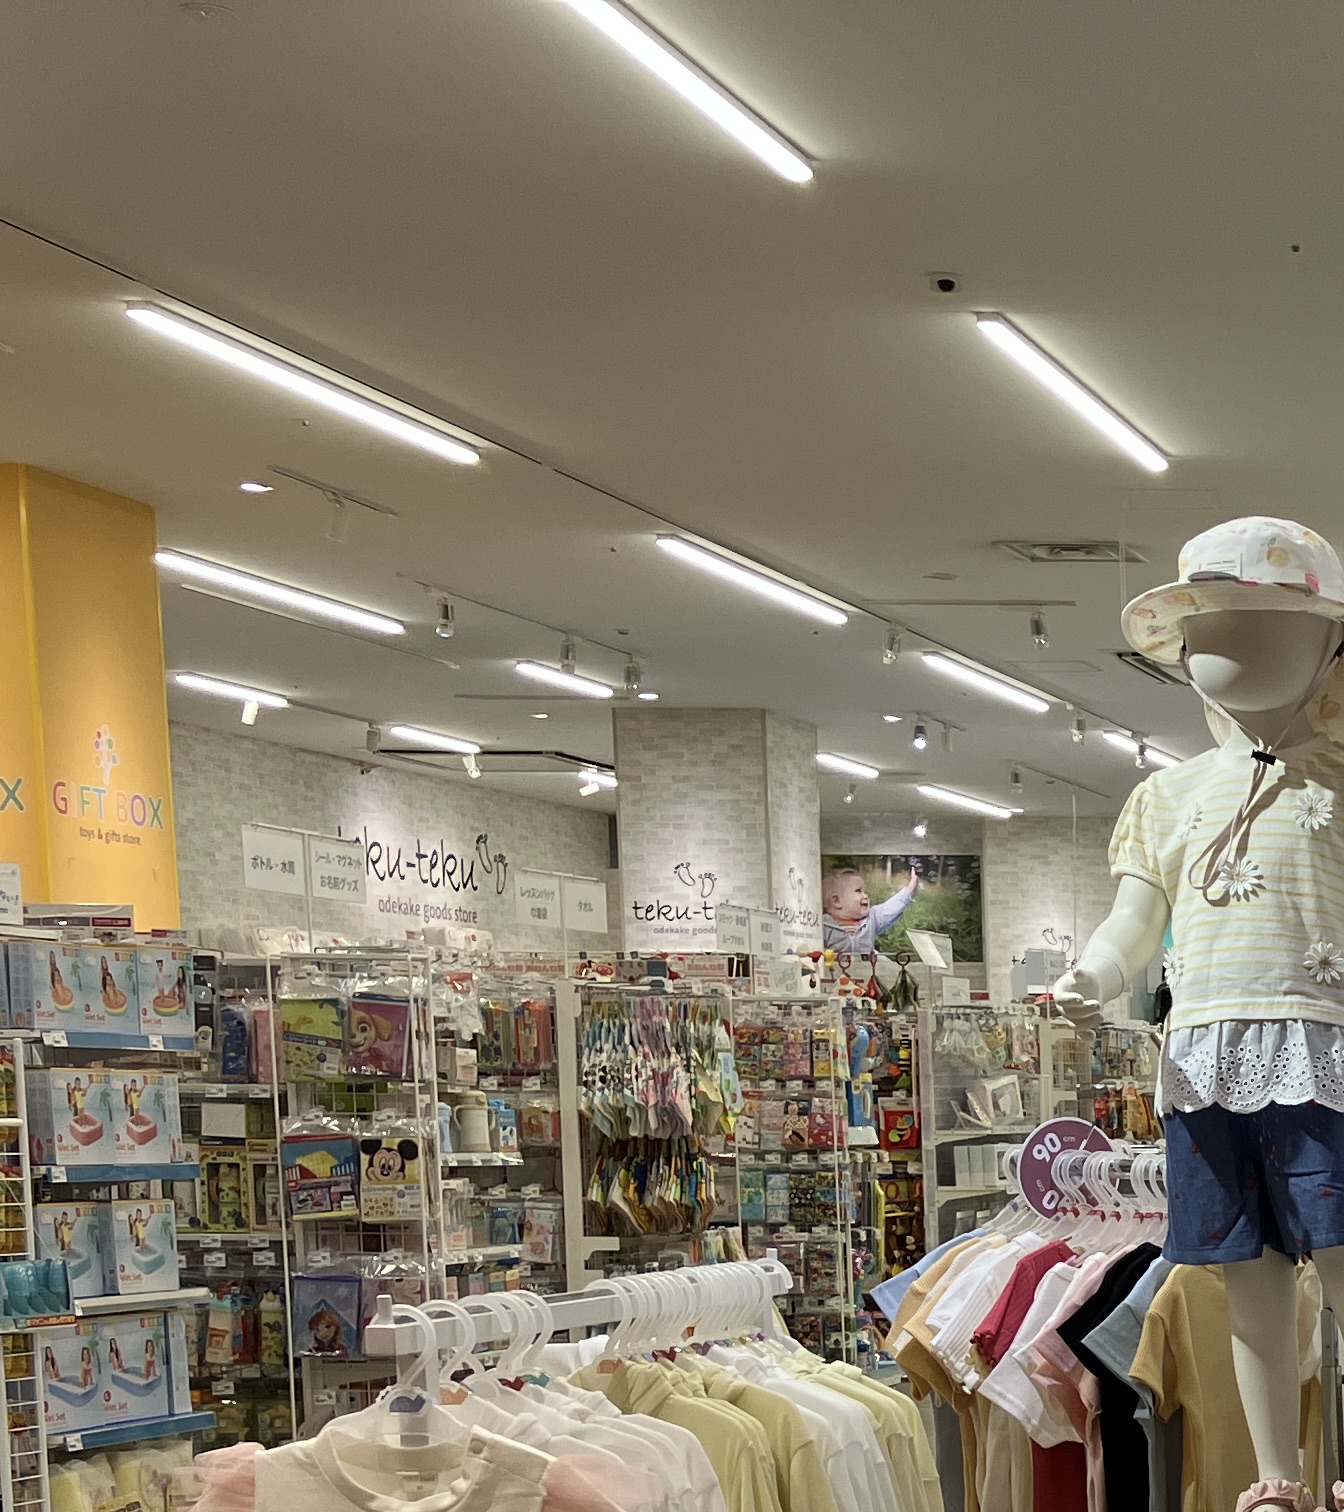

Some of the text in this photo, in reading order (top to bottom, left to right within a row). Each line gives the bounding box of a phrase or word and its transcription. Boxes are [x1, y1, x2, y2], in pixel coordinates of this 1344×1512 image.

[53, 781, 163, 829] GIFT BOX
[80, 826, 96, 841] toys
[105, 829, 121, 844] gifts
[123, 833, 141, 845] store
[338, 826, 478, 891] ku-teku
[378, 896, 478, 925] odekake goods store
[632, 899, 717, 923] teku-t
[653, 926, 691, 937] odekake
[1032, 1132, 1077, 1163] 90 cm
